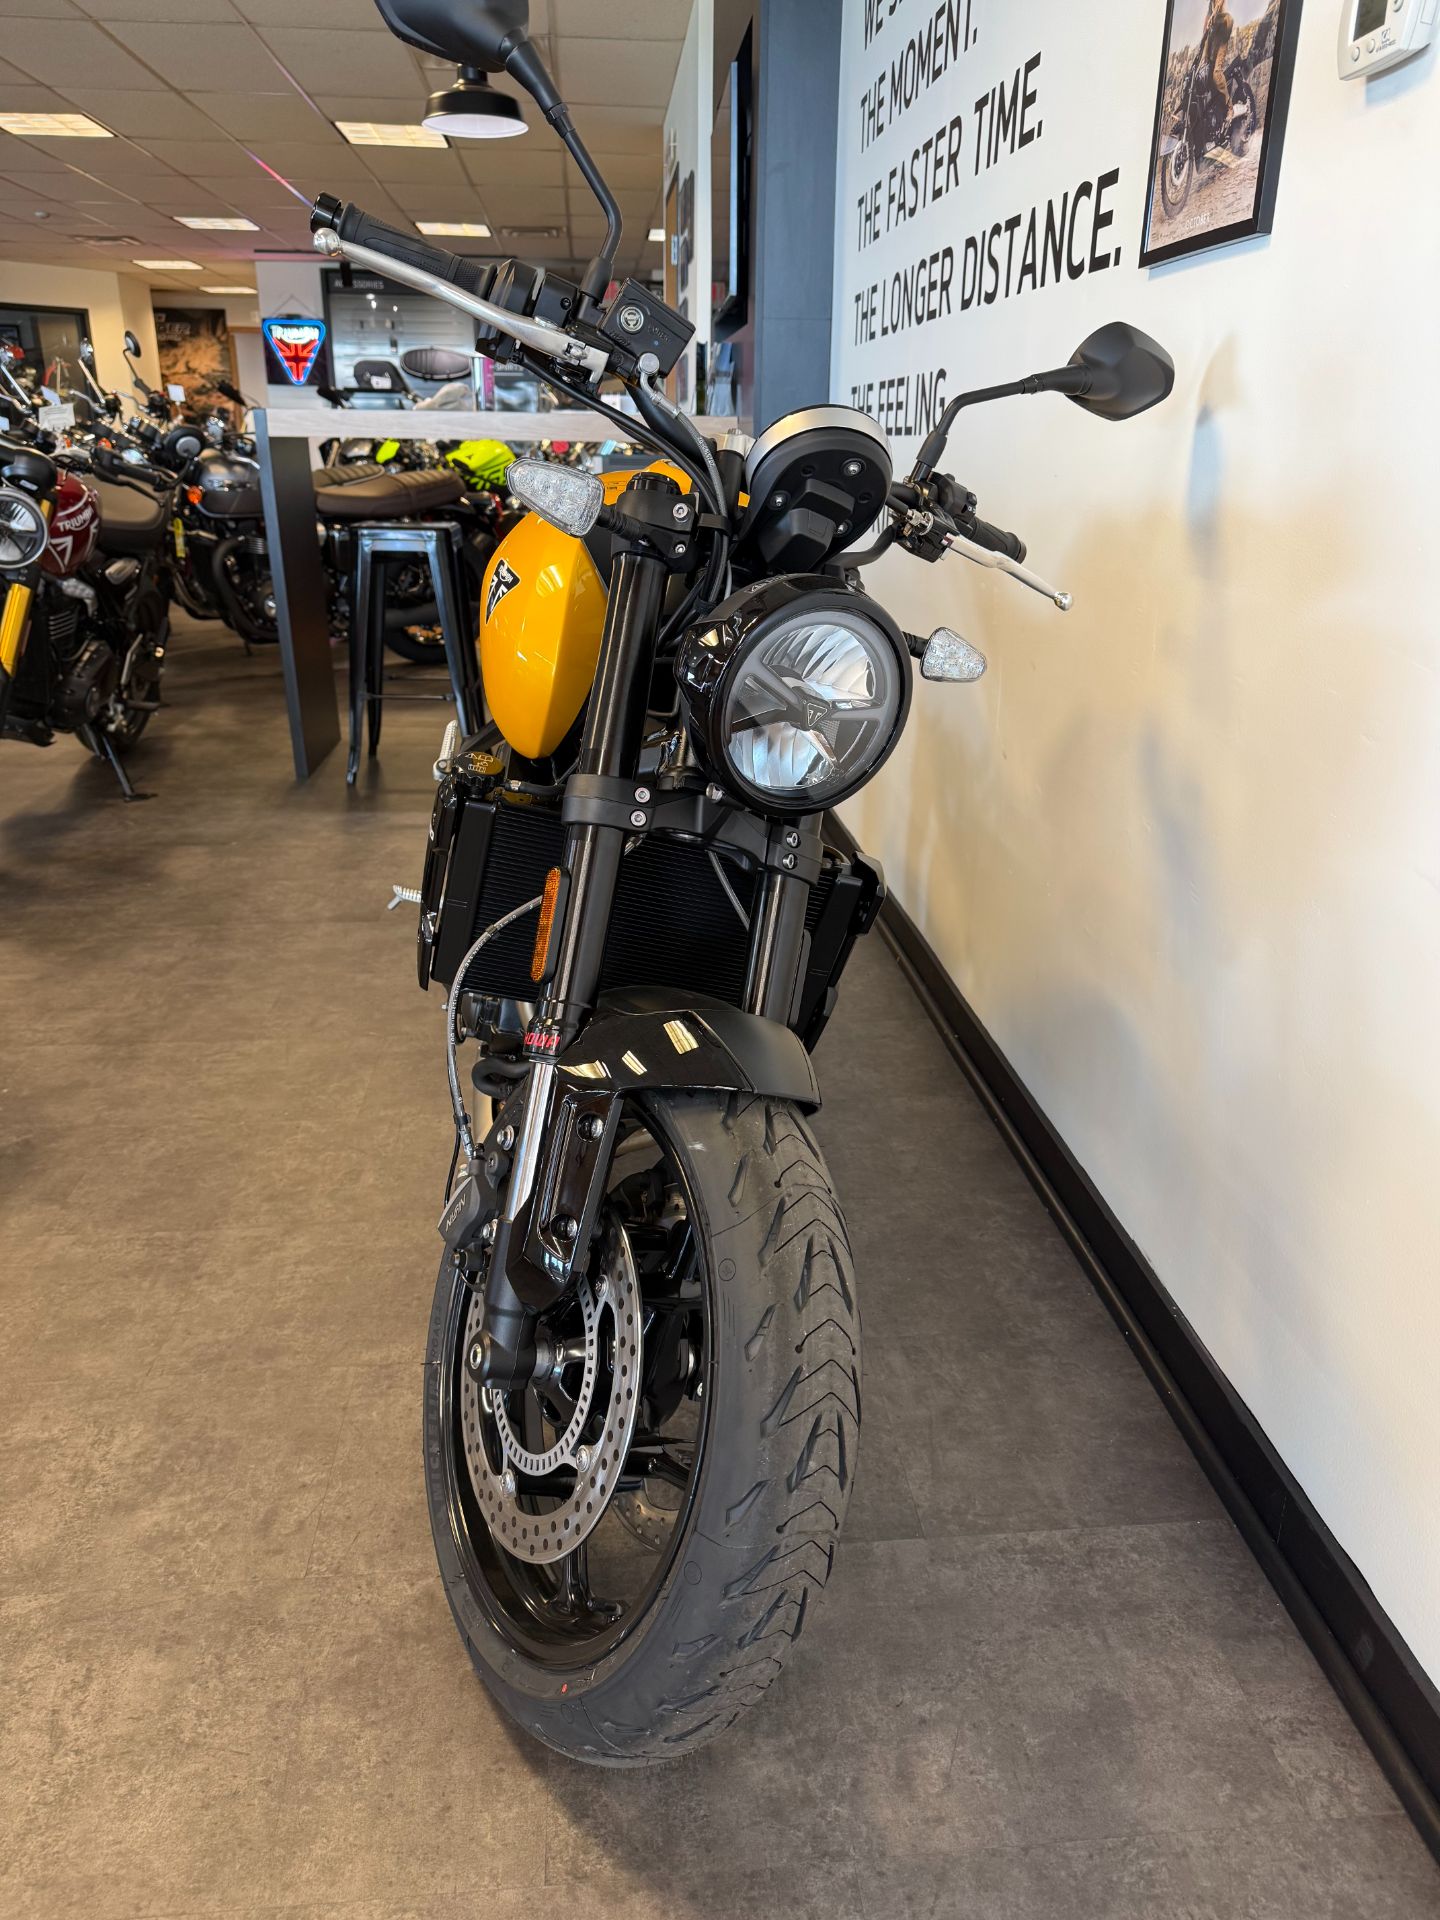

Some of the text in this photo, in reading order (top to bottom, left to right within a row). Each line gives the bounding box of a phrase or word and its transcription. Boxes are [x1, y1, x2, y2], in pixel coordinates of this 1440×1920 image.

[857, 51, 1043, 252] THE FASTER TIME.
[860, 0, 978, 153] THE MOMENT.
[334, 278, 384, 289] ACSSORIES
[854, 167, 1122, 346] THE LONGER DISTANCE.
[270, 324, 320, 345] TRIUMPH
